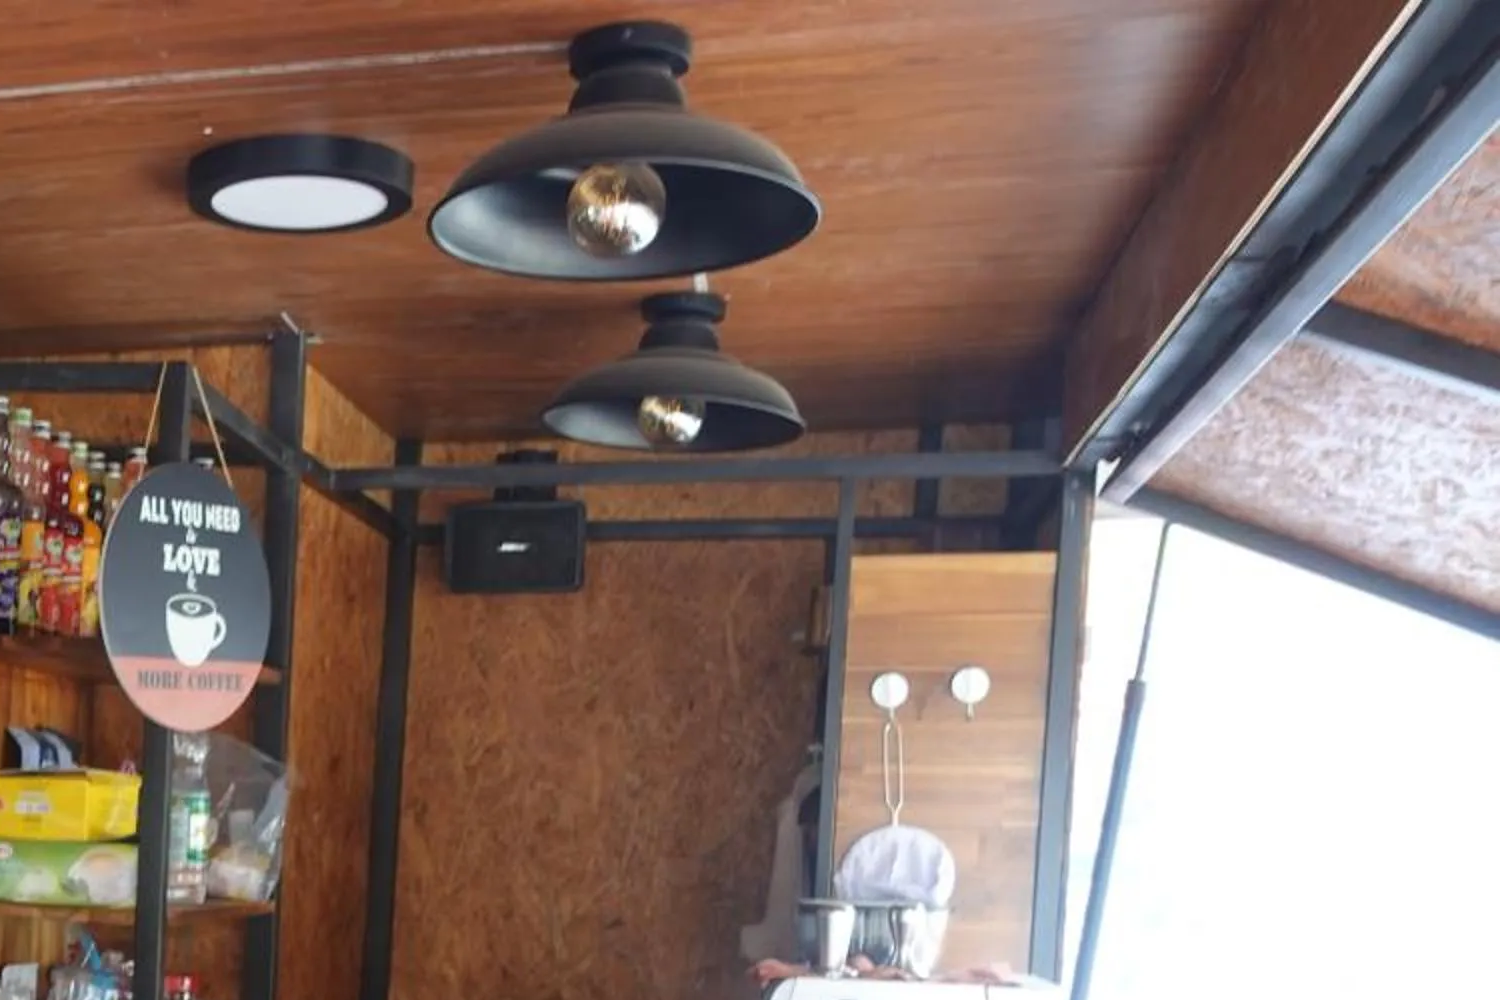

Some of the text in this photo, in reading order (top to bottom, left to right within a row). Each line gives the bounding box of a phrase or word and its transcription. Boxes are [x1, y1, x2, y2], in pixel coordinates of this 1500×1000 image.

[139, 495, 241, 534] ALL YOU NEED
[163, 543, 221, 577] LOVE
[137, 669, 243, 692] MORE COFFEE
